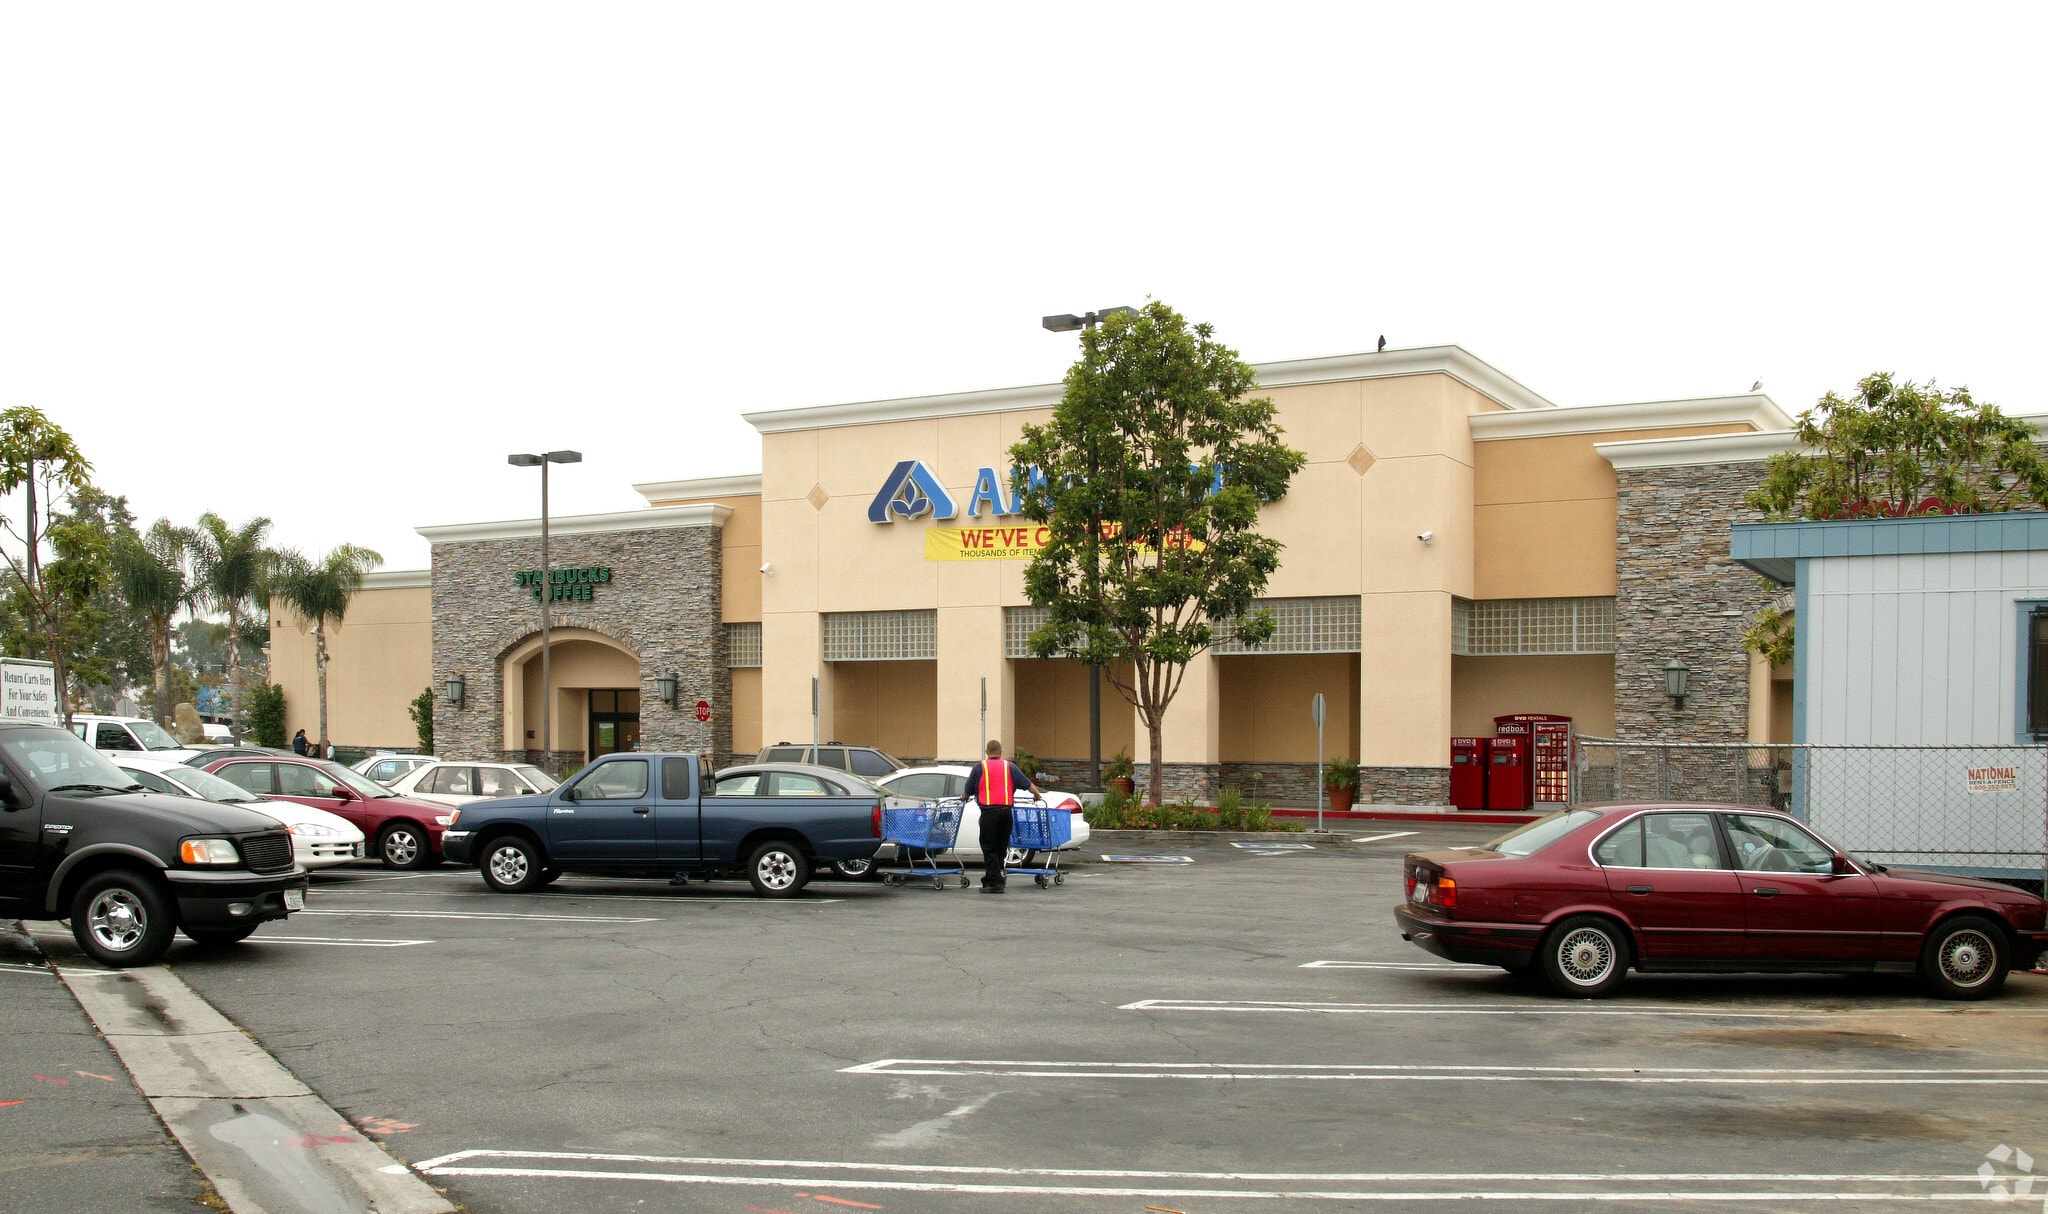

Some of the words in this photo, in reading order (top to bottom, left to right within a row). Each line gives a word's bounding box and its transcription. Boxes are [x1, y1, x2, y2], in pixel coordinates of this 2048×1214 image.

[960, 527, 1028, 548] WE'VE
[960, 549, 1007, 558] THOUSANDS
[1009, 549, 1021, 557] OF
[1022, 548, 1041, 556] ITEM
[532, 584, 592, 601] CFFEE
[4, 671, 24, 683] Return
[24, 672, 39, 684] Carts
[39, 674, 52, 686] Here
[8, 688, 18, 700] For
[19, 689, 32, 701] Your
[32, 690, 48, 704] Safety
[6, 706, 17, 717] And
[695, 707, 711, 716] STOP
[1498, 725, 1524, 733] redbox
[1968, 768, 2016, 781] NATIONAL
